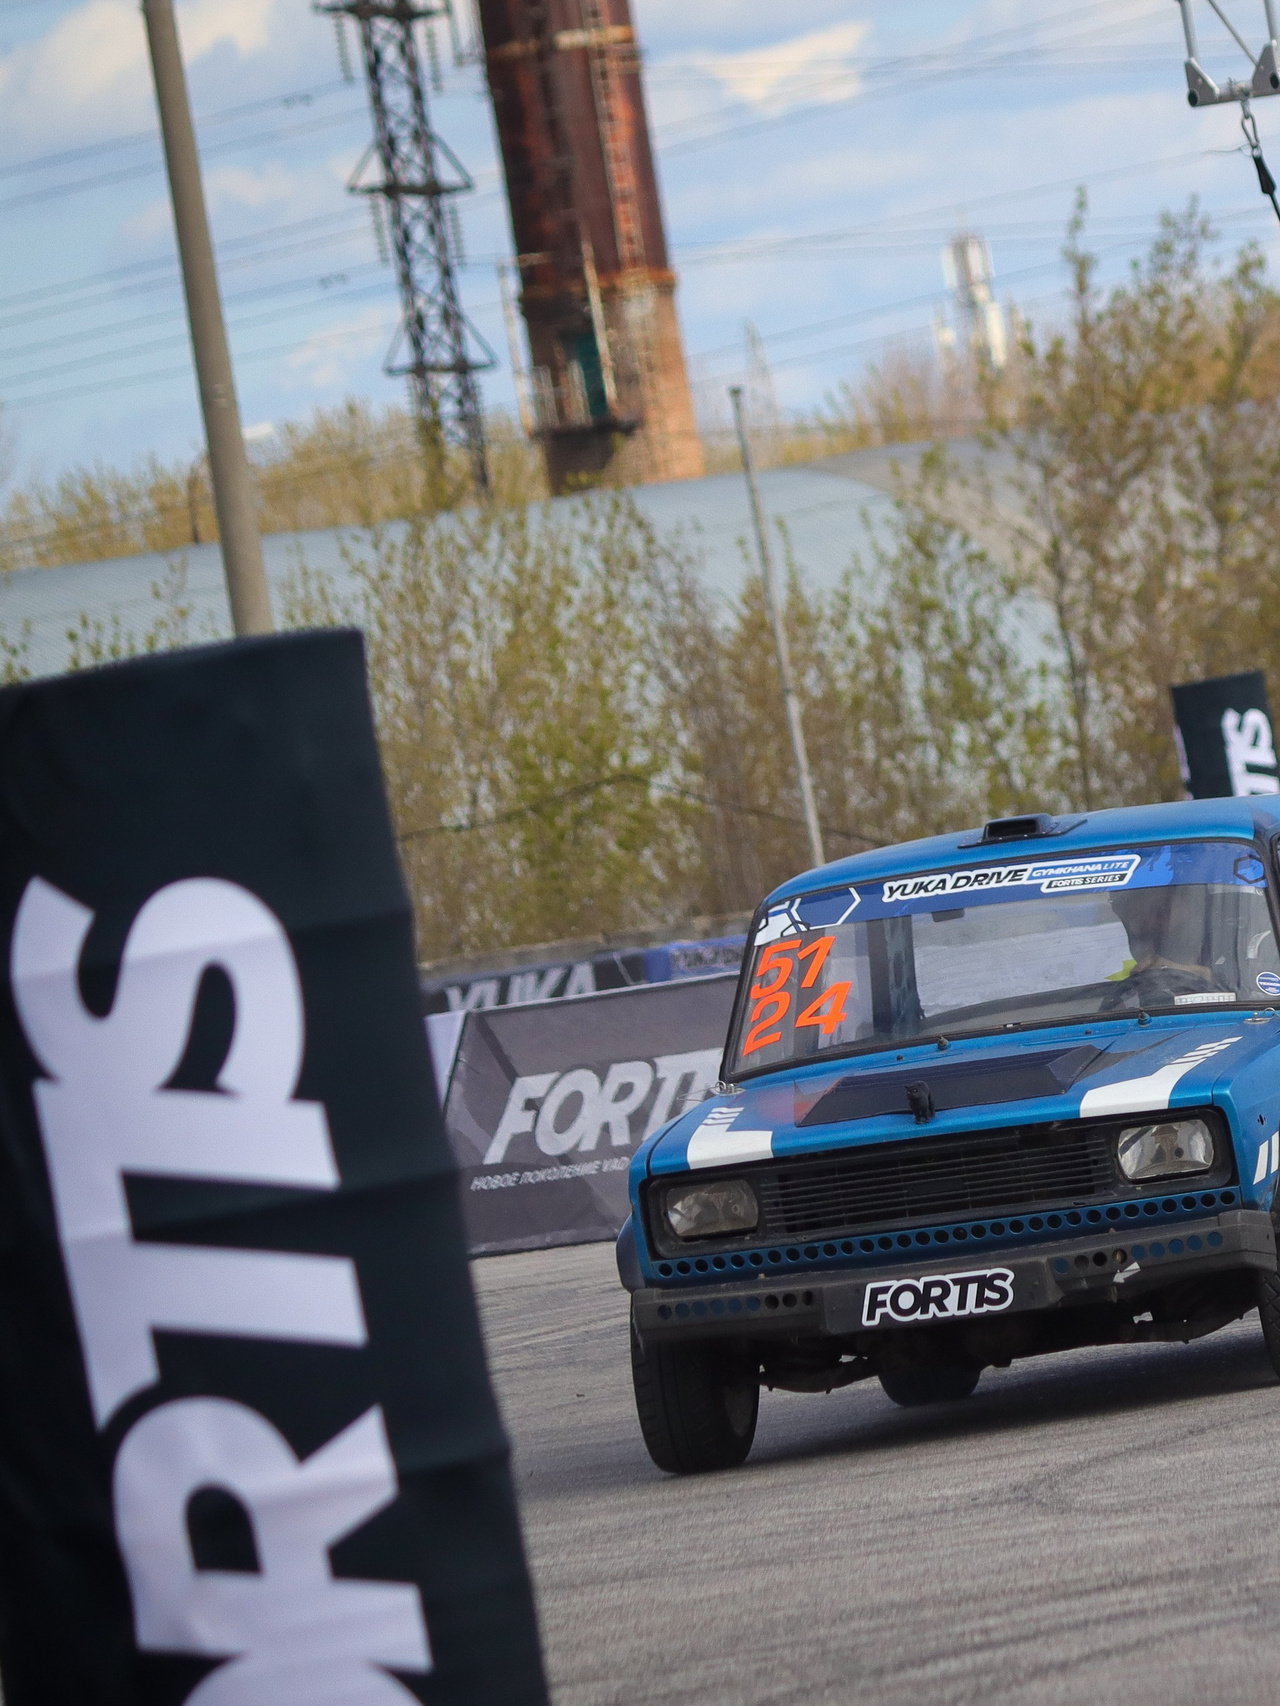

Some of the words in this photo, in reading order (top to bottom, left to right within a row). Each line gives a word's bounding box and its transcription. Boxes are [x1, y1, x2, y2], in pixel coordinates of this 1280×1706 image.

[886, 877, 947, 899] YUKA
[951, 868, 1028, 890] DRIVE
[1031, 862, 1103, 878] GYMKHANA
[1103, 860, 1130, 871] LITE
[1050, 877, 1086, 889] FORTIS
[1085, 873, 1121, 885] SERIES
[750, 935, 836, 1000] 51
[742, 981, 852, 1057] 24
[483, 1047, 723, 1165] FORTI
[10, 875, 434, 1706] RTIS
[866, 1272, 1010, 1322] FORTIS
